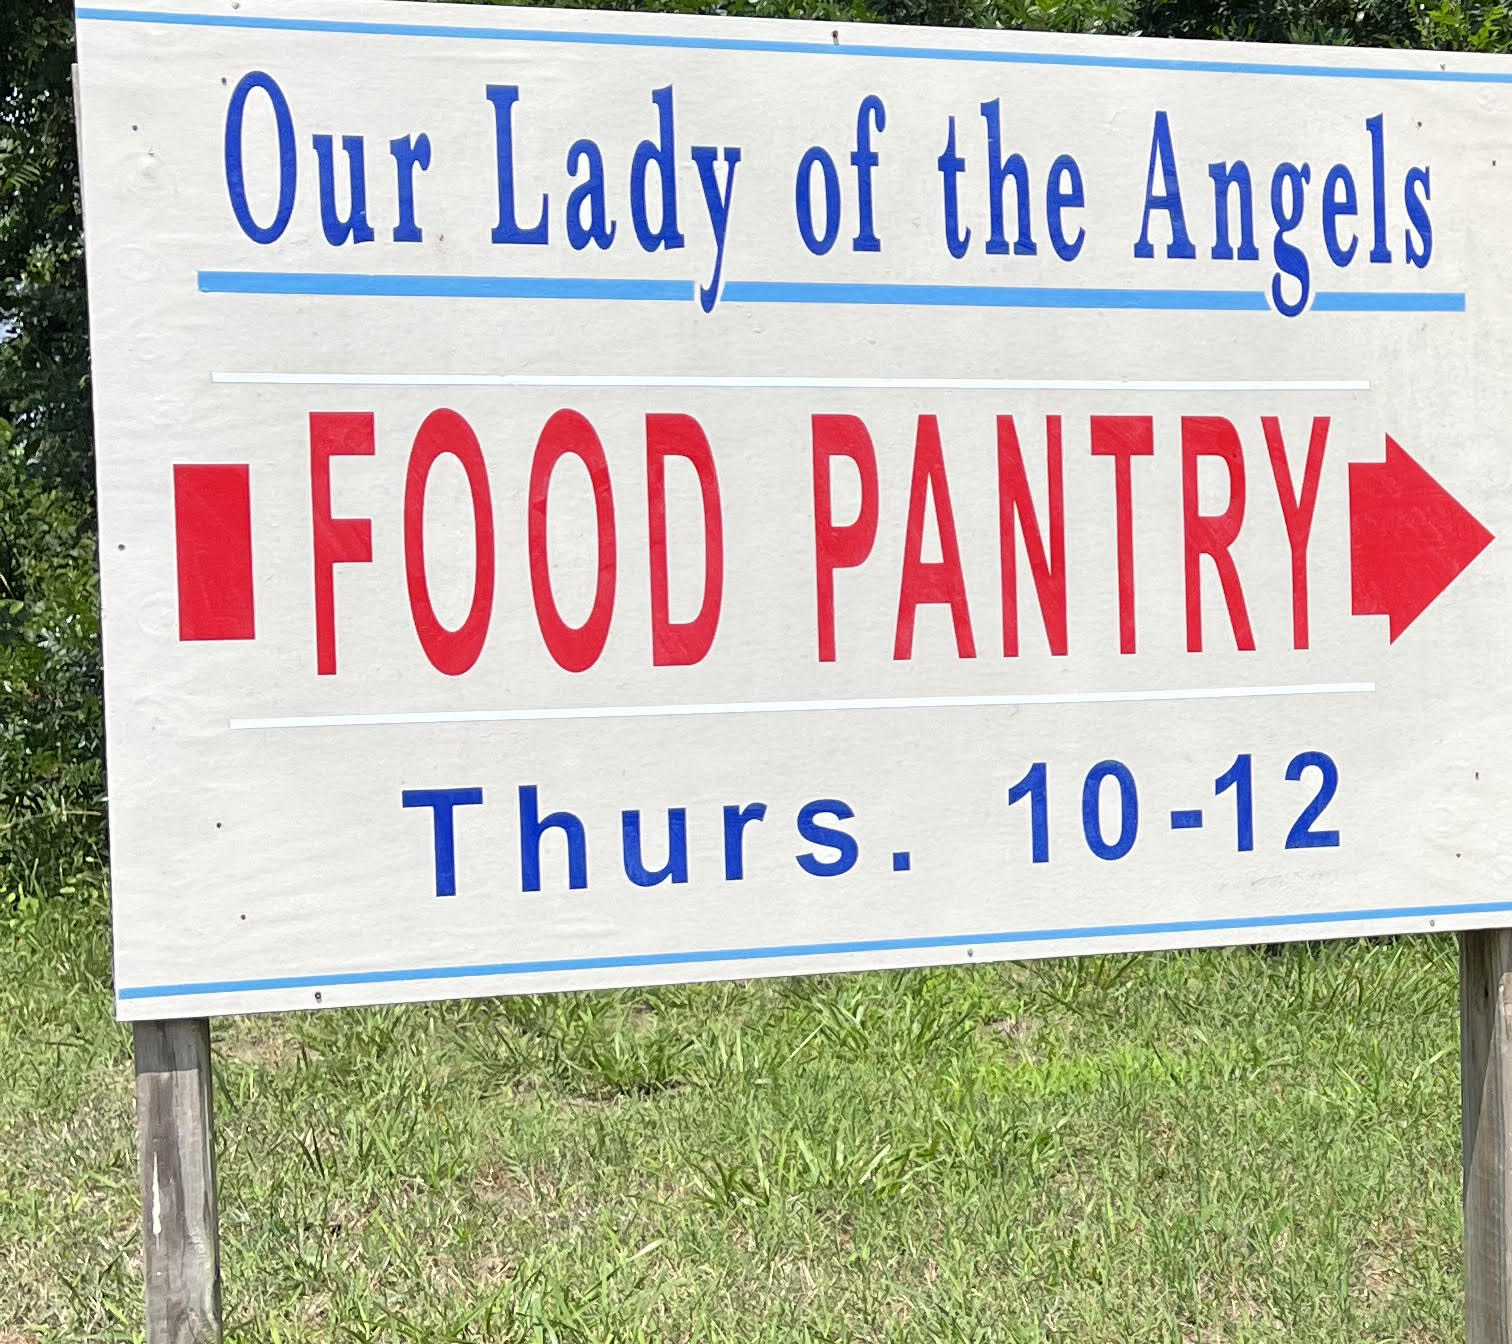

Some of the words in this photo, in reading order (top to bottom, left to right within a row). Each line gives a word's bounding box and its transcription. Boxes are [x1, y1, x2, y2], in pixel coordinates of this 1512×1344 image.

[224, 71, 432, 248] Our
[485, 85, 743, 314] Lady
[794, 94, 887, 256] of
[937, 99, 1086, 263] the
[1133, 110, 1433, 318] Angels
[309, 408, 725, 676] FOOD
[810, 413, 1331, 664] PANTRY
[401, 785, 911, 897] Thurs.
[1007, 750, 1341, 863] 10-12
